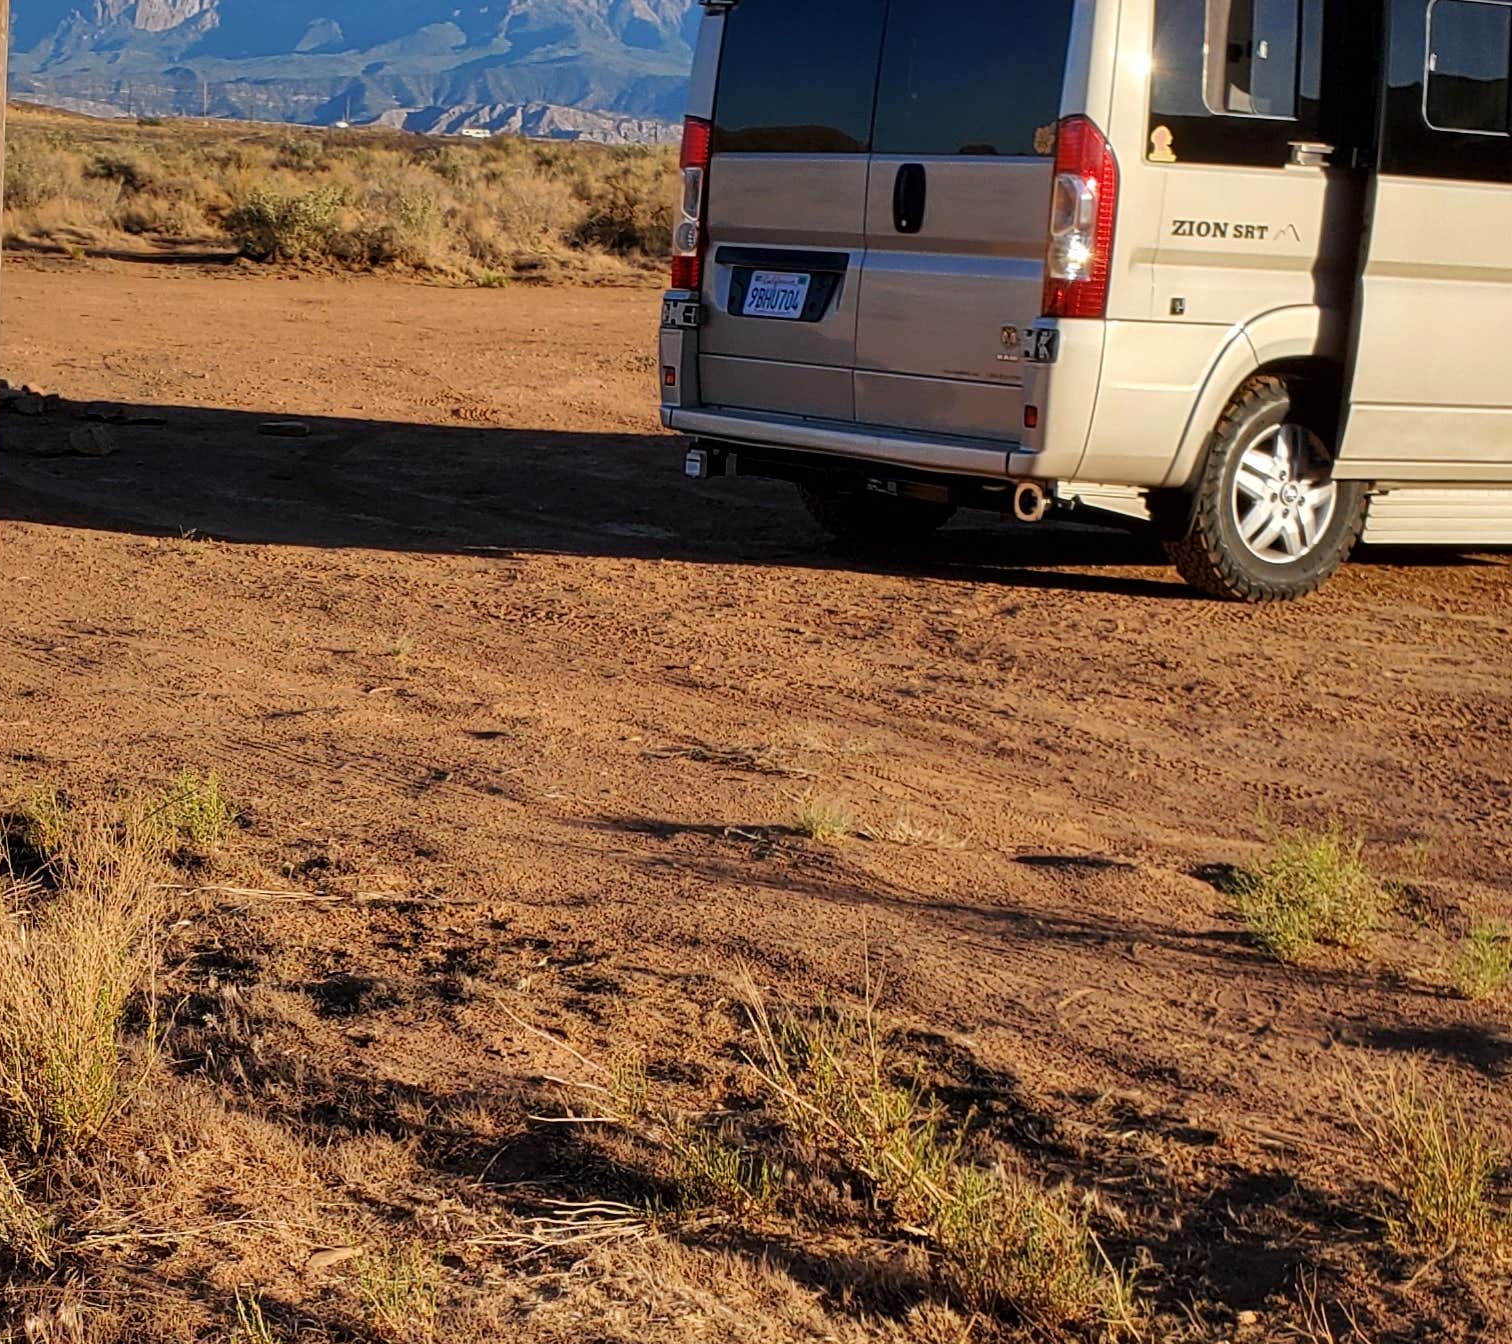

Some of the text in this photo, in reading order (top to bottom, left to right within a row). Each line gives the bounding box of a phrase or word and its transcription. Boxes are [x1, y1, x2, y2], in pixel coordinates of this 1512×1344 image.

[1171, 219, 1269, 239] ZION SRT
[747, 287, 801, 311] 9BHU704
